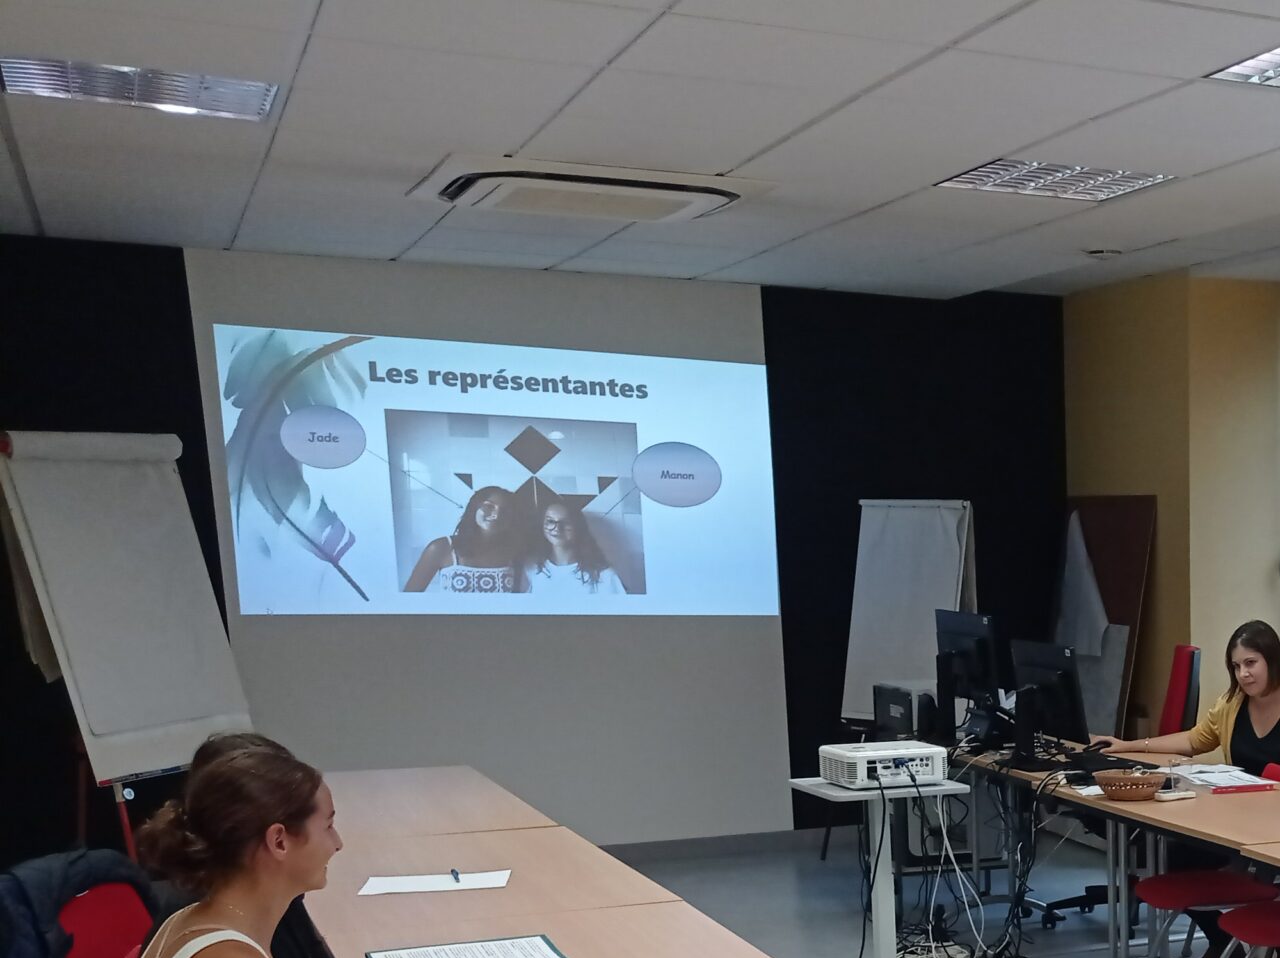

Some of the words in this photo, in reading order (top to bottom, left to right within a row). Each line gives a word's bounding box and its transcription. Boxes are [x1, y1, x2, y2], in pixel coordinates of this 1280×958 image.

[368, 361, 418, 385] Les
[428, 369, 649, 400] représentantes
[308, 431, 340, 443] Jade
[660, 470, 695, 480] Manon
